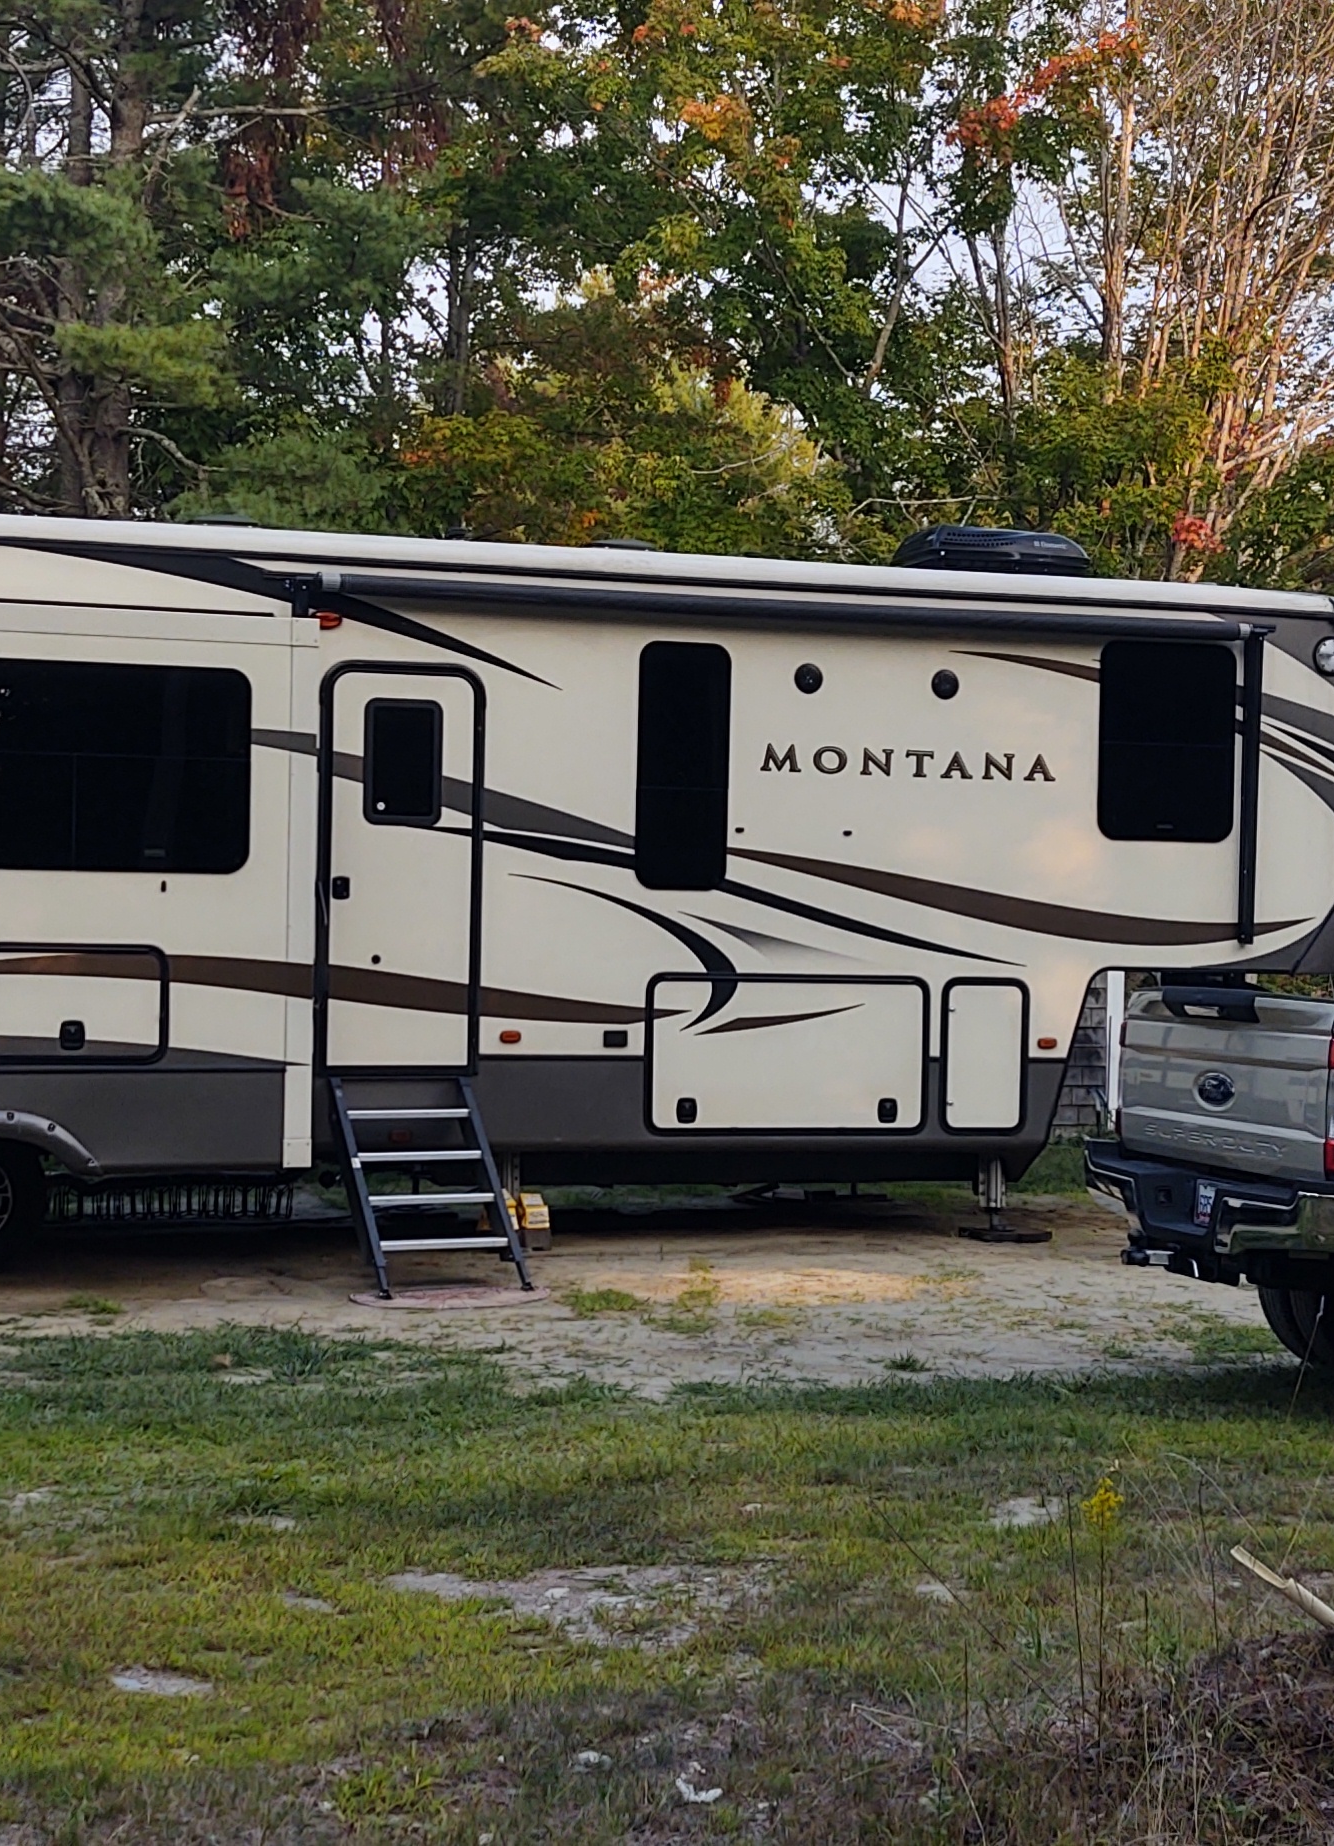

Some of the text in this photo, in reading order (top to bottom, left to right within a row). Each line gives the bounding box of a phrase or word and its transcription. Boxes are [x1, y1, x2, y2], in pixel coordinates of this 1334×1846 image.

[760, 742, 1056, 782] MONTANA
[1144, 1123, 1287, 1158] SUPER DUTY
